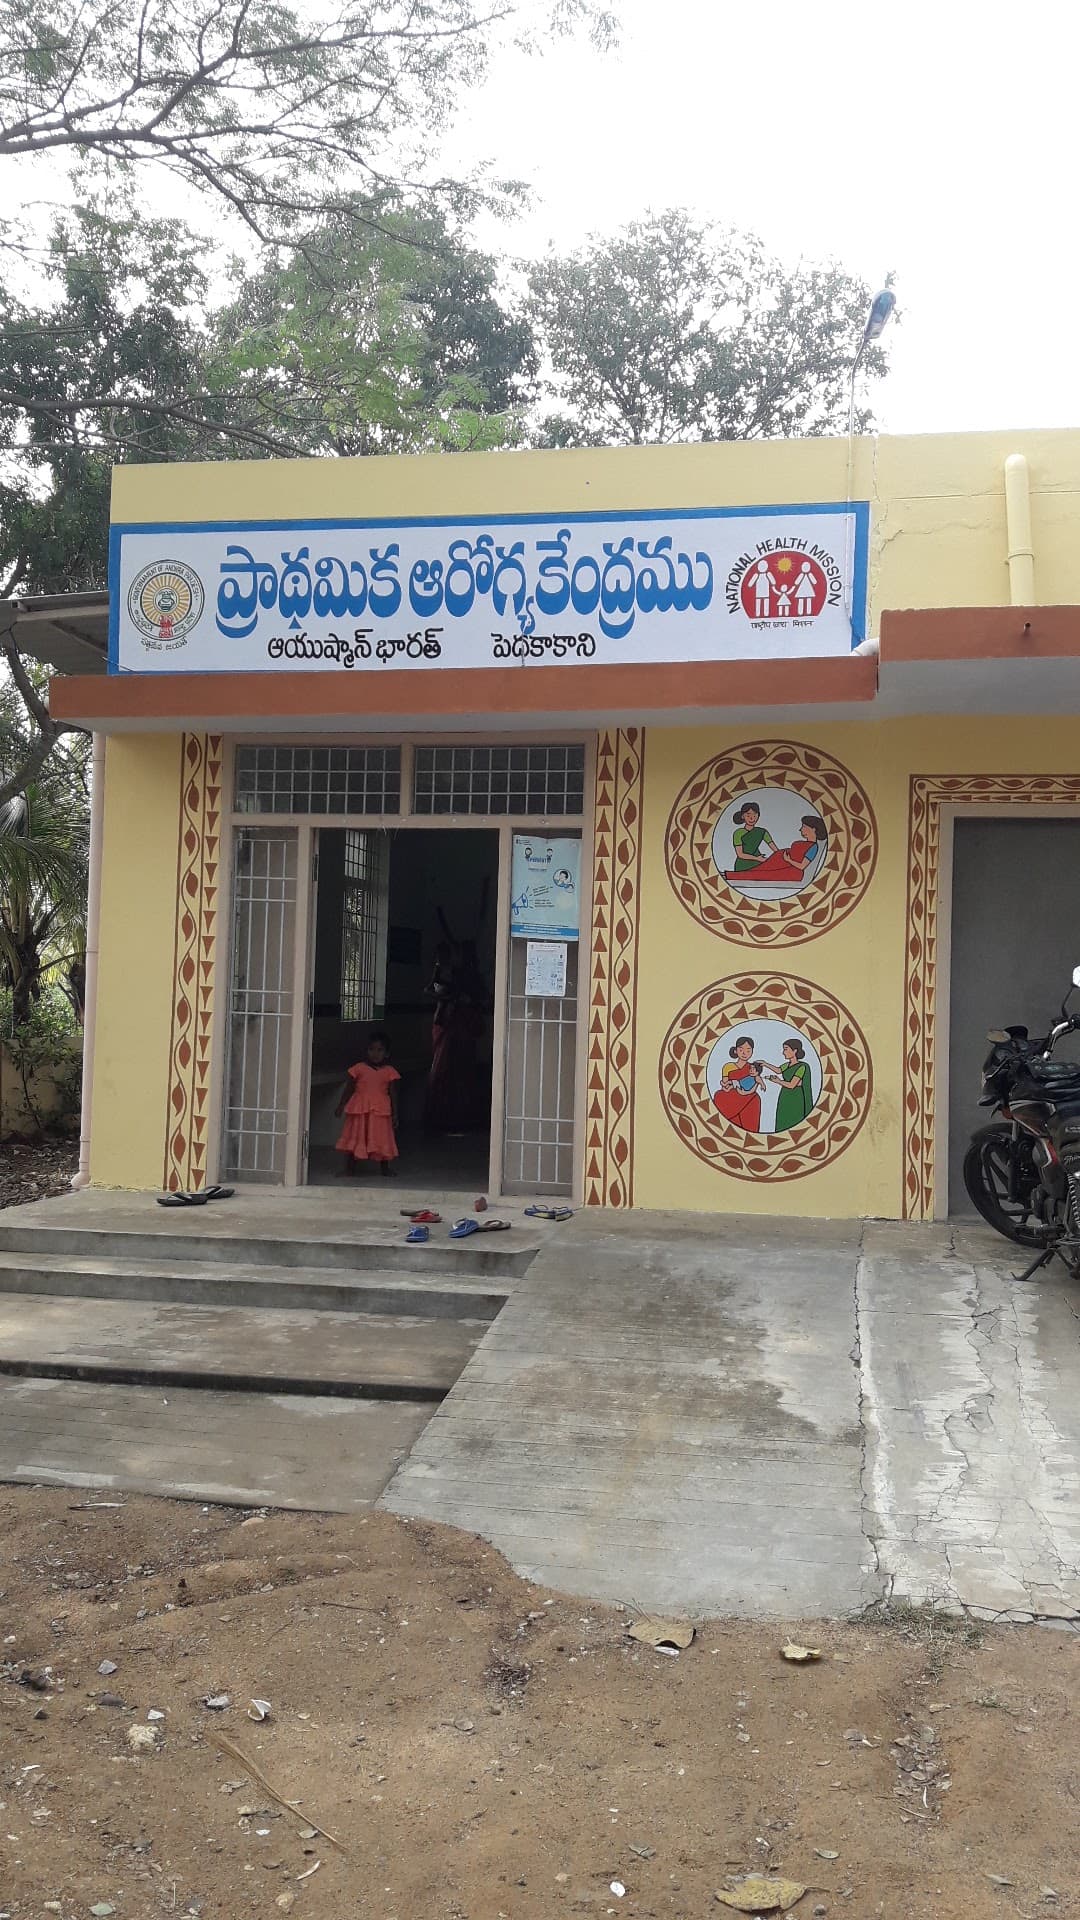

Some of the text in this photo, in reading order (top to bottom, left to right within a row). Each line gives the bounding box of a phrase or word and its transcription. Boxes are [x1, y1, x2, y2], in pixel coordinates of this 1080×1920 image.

[725, 537, 842, 614] NATIONAL HEALTH MISSION
[268, 628, 374, 668] ఆయుష్మాన్
[375, 627, 444, 664] భారత్
